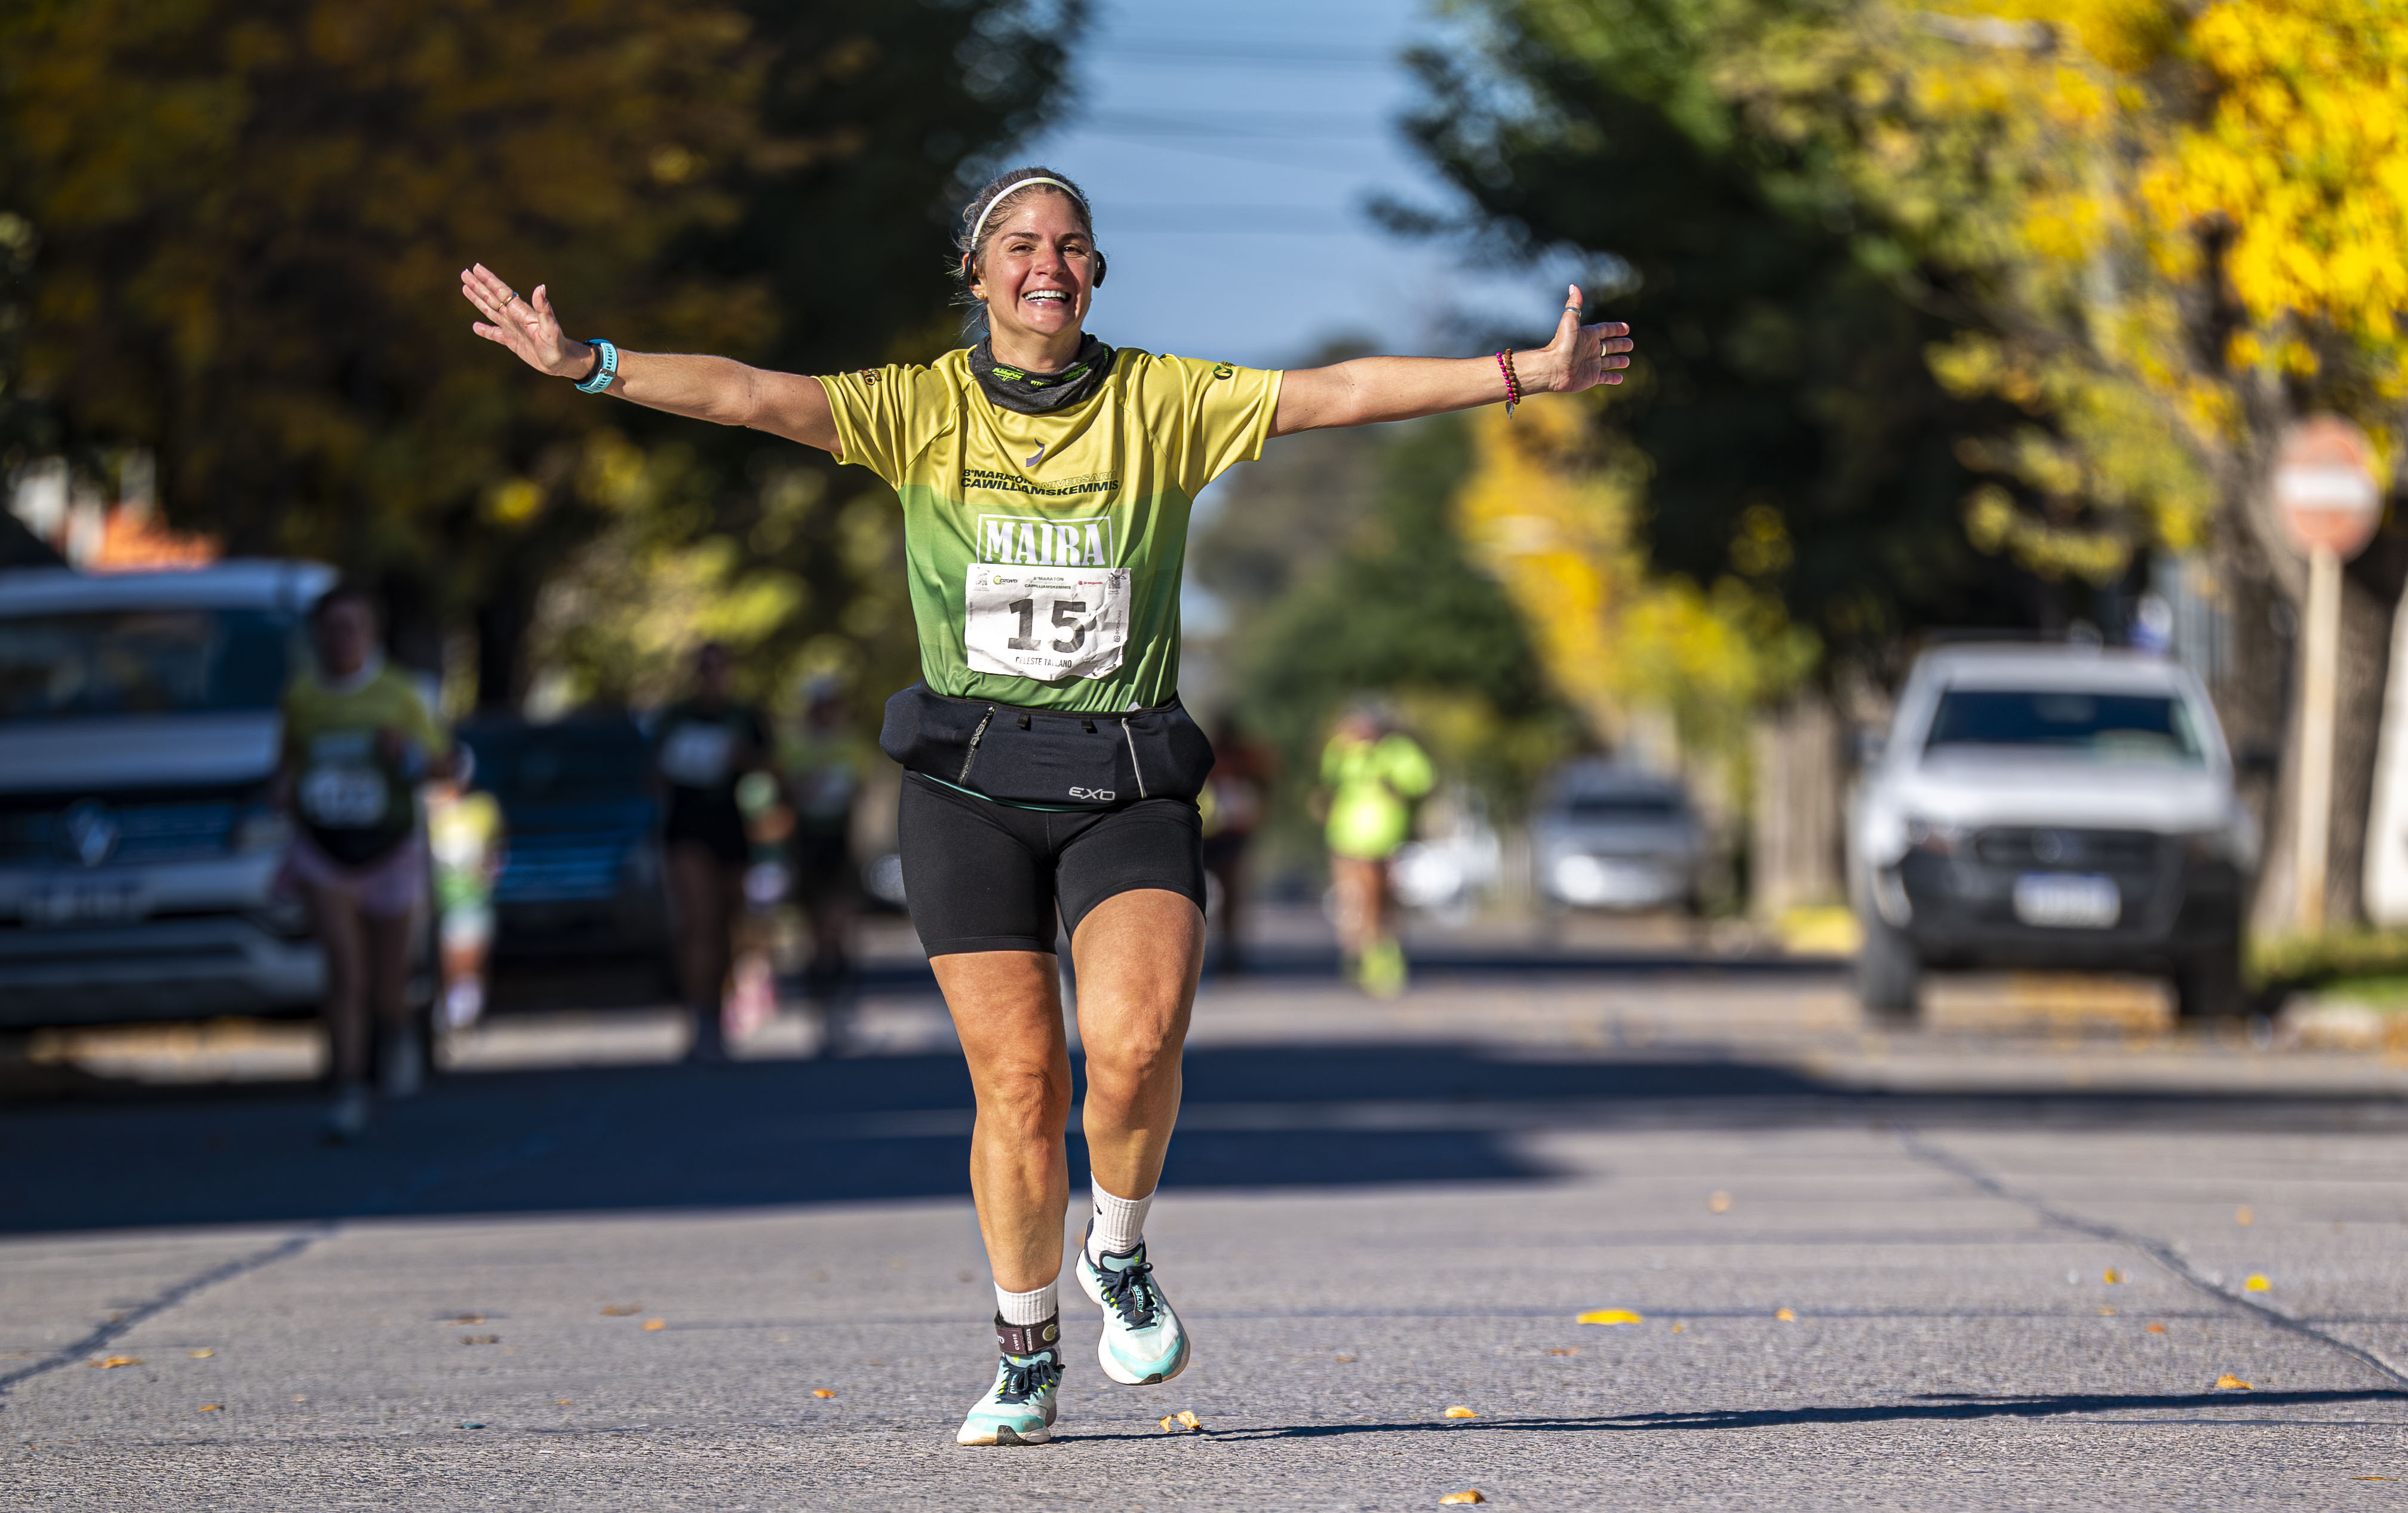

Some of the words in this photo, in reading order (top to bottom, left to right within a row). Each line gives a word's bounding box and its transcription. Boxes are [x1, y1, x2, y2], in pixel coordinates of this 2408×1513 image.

[984, 520, 1105, 566] MAIRA
[1008, 598, 1097, 653] 15
[1015, 656, 1042, 665] CELESTE
[1068, 786, 1116, 801] EXO
